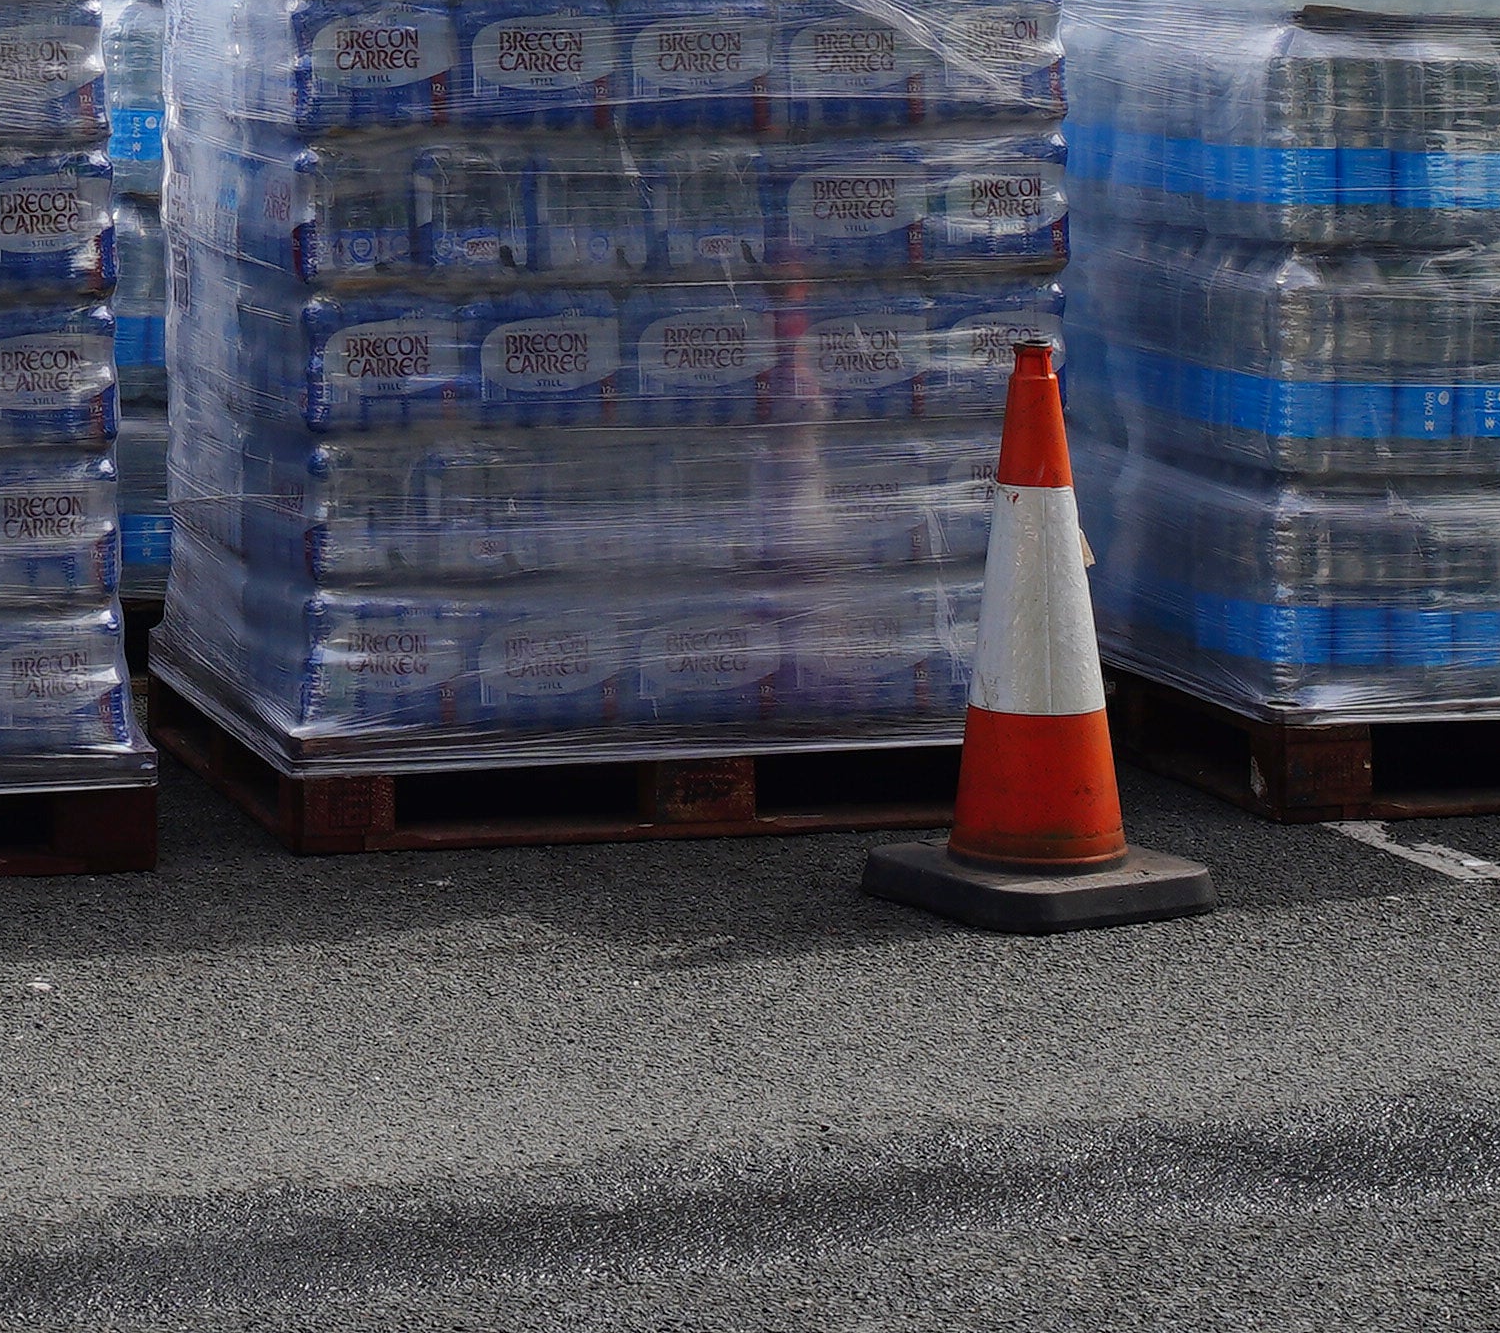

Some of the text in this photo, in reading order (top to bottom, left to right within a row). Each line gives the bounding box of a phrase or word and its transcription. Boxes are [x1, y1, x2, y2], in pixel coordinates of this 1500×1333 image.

[336, 29, 419, 50] BRECON
[499, 32, 582, 52] BRECON
[658, 33, 741, 52] BRECON
[336, 50, 420, 70] CARREG
[499, 52, 583, 72] CARREG
[658, 52, 742, 72] CARREG
[367, 74, 392, 83] STILL
[813, 179, 895, 200] BRECON
[0, 193, 79, 212] BRECON
[813, 200, 895, 220] CARREG
[346, 336, 429, 357] BRECON
[506, 333, 588, 354] BRECON
[663, 326, 745, 348] BRECON
[346, 357, 431, 378] CARREG
[506, 354, 589, 374] CARREG
[663, 348, 745, 369] CARREG
[3, 497, 84, 518] BRECON
